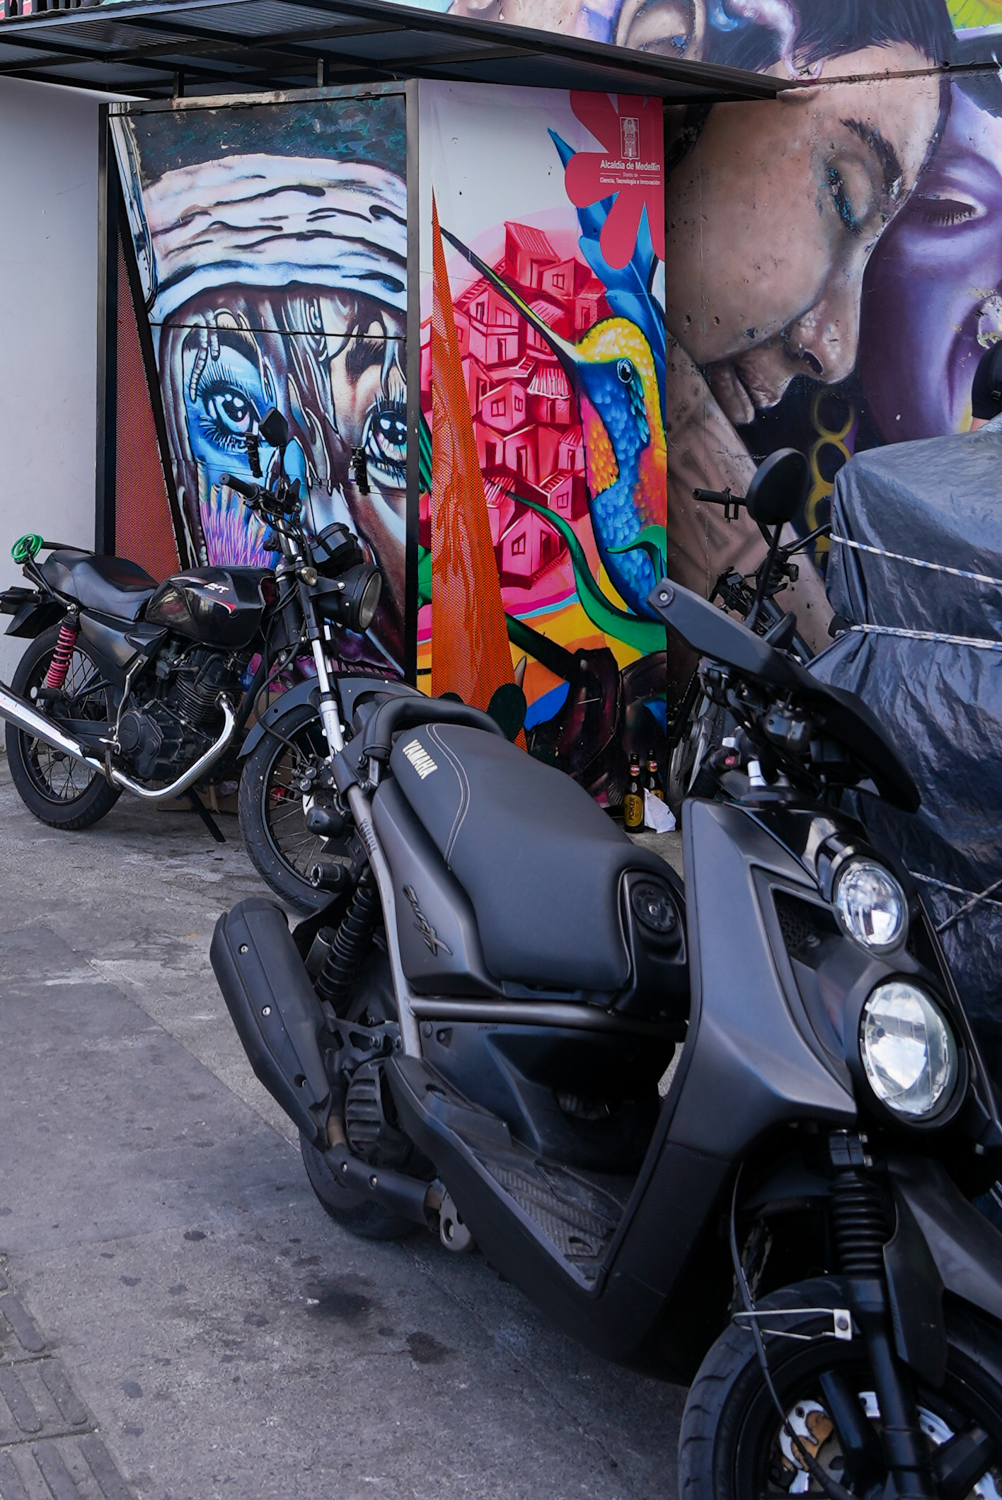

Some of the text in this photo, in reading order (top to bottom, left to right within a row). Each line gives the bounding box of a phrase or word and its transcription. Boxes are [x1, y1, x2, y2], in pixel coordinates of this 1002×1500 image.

[600, 160, 625, 169] Alcaldía
[626, 161, 635, 170] de
[402, 739, 438, 780] YAMAHA
[628, 797, 636, 820] POKER
